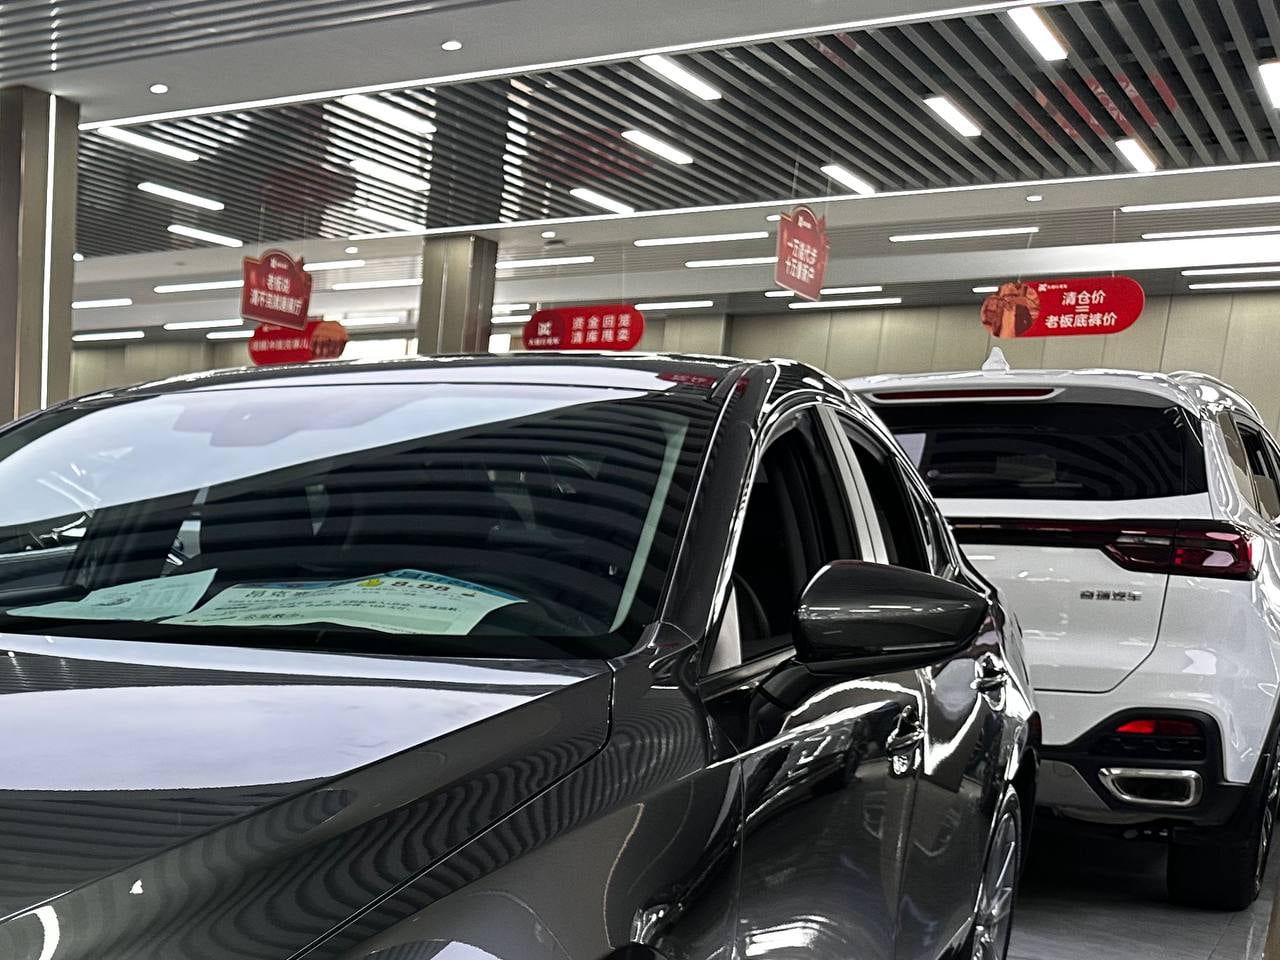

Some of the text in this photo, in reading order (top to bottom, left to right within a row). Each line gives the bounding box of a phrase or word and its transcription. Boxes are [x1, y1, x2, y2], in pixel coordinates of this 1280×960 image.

[1061, 290, 1106, 306] 清仓价
[1045, 312, 1118, 328] 老板底裤价
